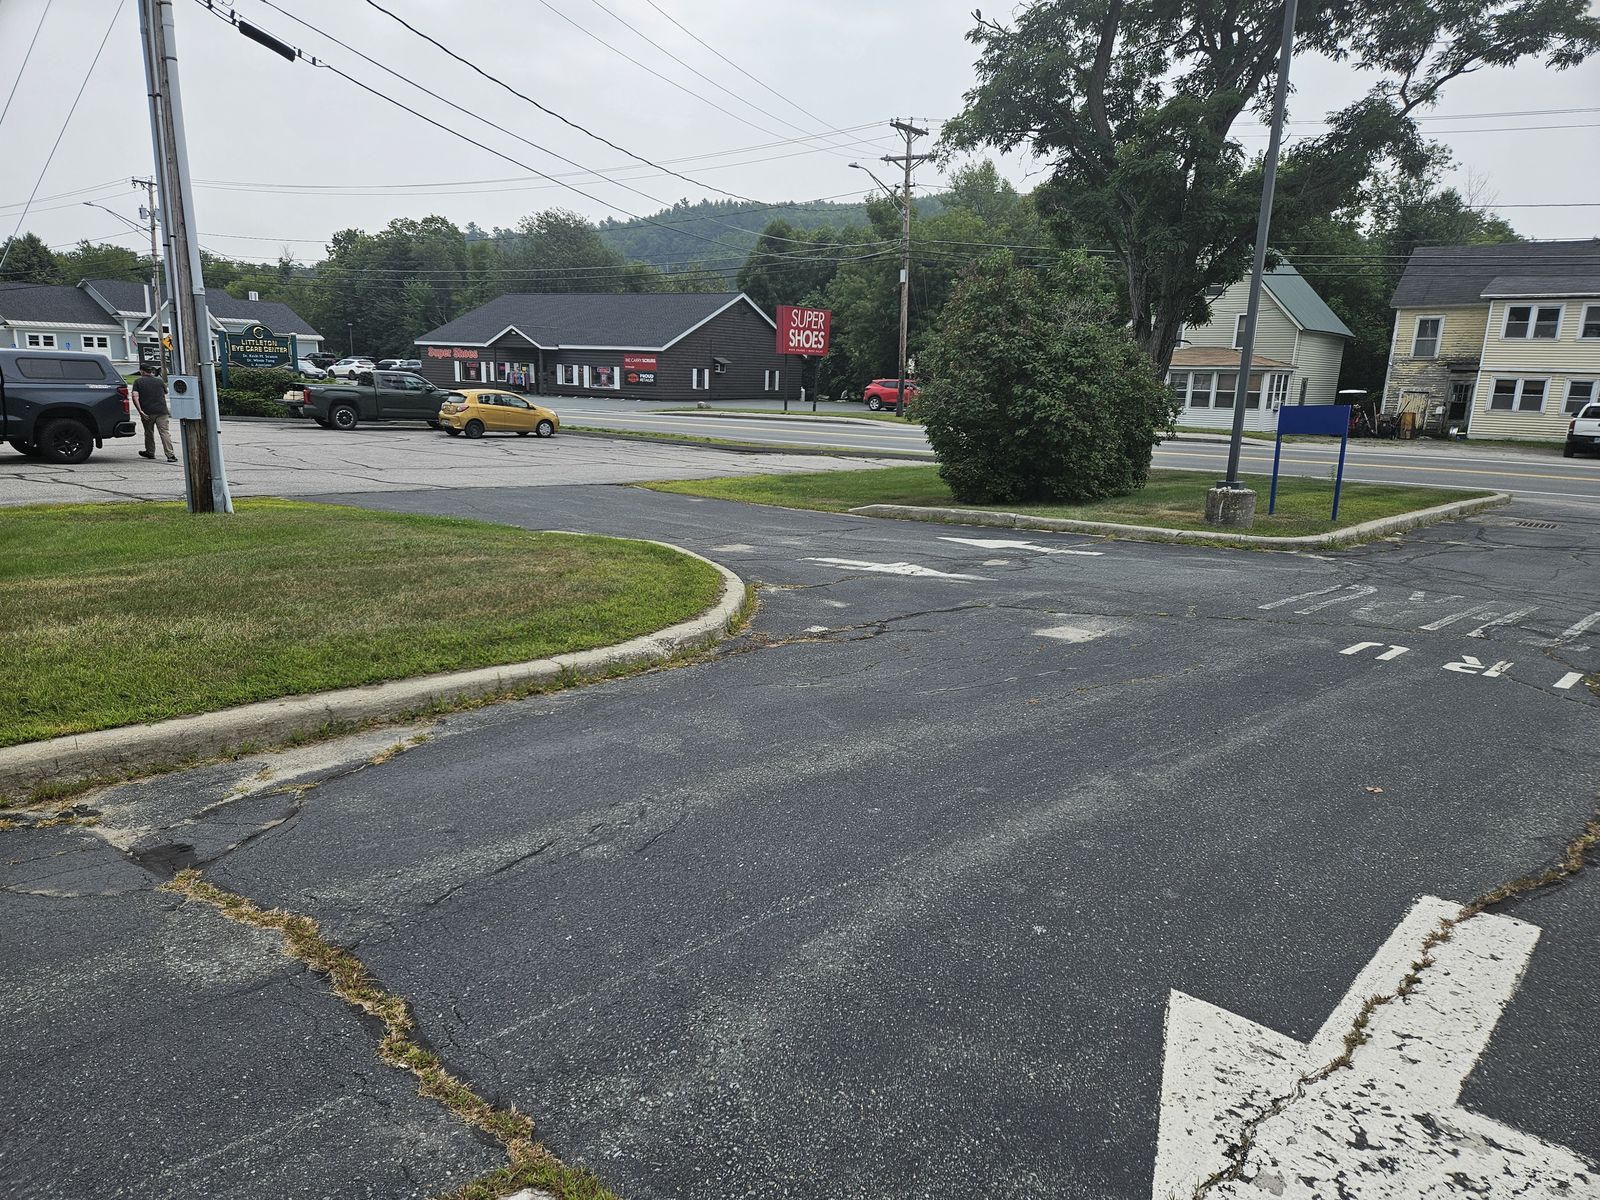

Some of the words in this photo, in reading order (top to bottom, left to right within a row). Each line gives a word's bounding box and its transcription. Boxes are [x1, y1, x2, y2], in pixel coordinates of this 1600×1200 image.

[791, 309, 825, 329] SUPER
[789, 328, 825, 349] SHOES
[245, 345, 263, 353] CARE
[427, 346, 452, 359] Super
[453, 346, 479, 359] Shoes
